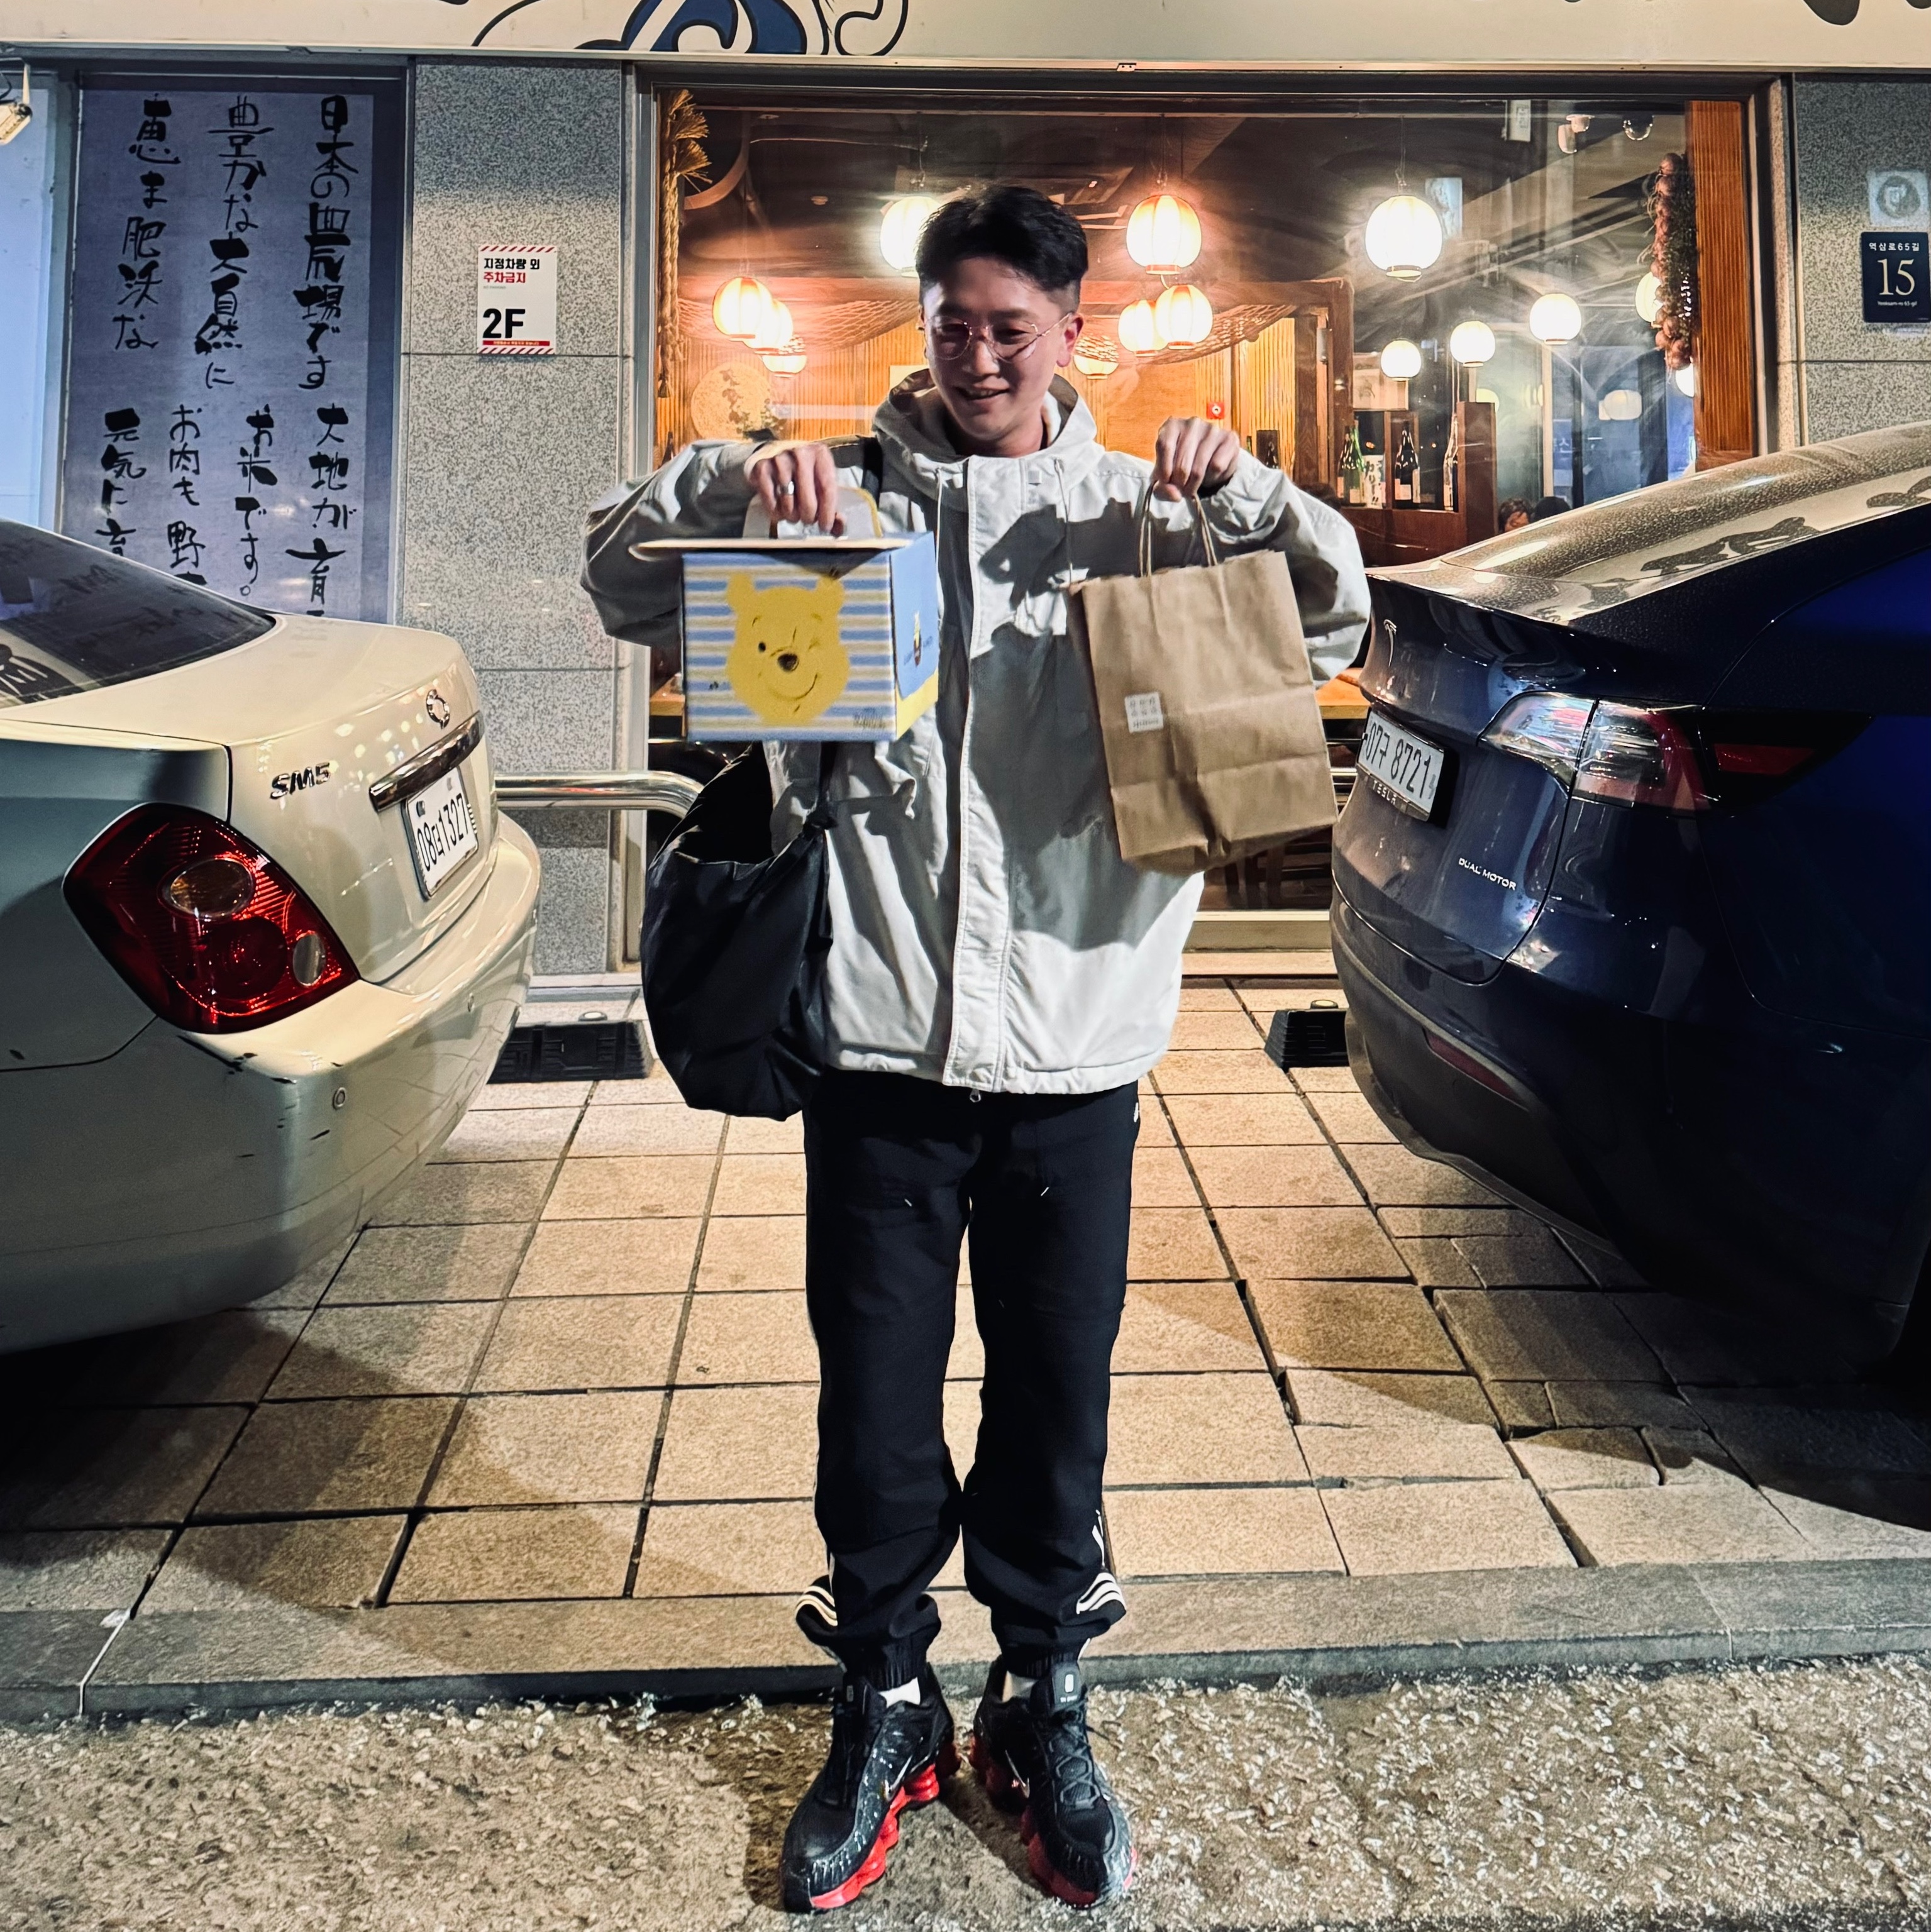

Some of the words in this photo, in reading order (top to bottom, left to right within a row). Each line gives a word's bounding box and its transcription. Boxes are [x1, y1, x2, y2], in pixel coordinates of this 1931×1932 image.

[1869, 242, 1920, 251] 역삼로65길
[484, 258, 526, 270] 지정차량
[530, 258, 539, 270] 외
[484, 272, 526, 283] 주차금지
[1877, 258, 1915, 295] 15
[482, 308, 526, 339] 2F
[270, 761, 331, 800] SM5
[1391, 738, 1431, 798] 8721
[1373, 780, 1397, 806] TESLA
[1458, 858, 1481, 875] DUAL
[1482, 869, 1517, 891] MOTOR
